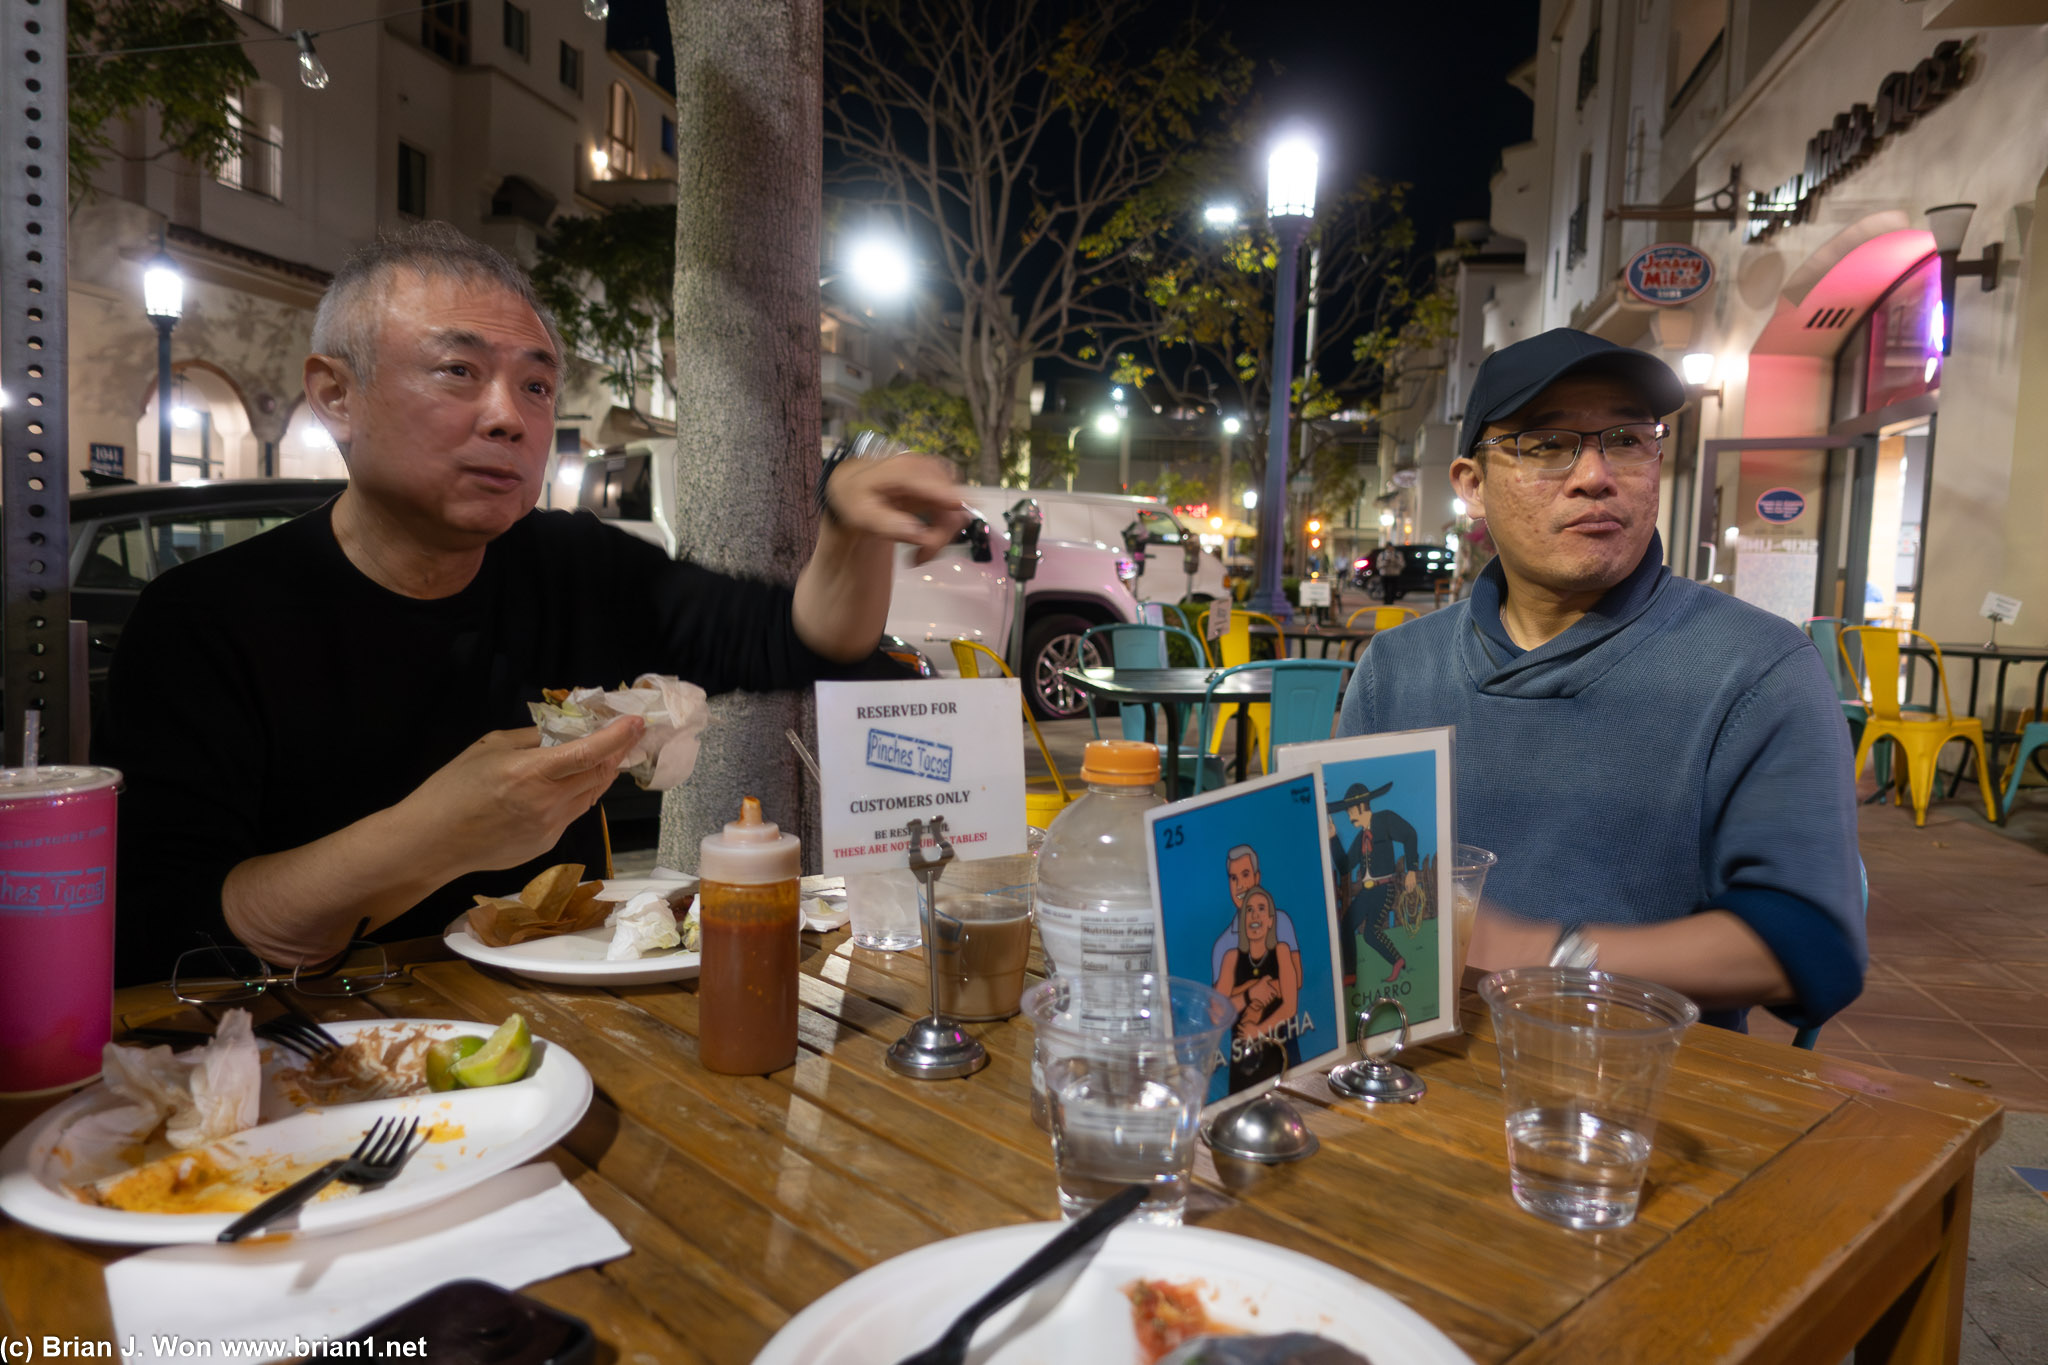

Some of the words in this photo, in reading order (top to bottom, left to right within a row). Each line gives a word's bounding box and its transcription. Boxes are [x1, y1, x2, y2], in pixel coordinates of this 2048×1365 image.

[856, 703, 928, 720] RESERVED
[931, 701, 957, 715] FOR
[869, 734, 914, 768] Pinches
[917, 746, 949, 775] Tacos
[850, 794, 933, 814] CUSTOMERS
[935, 790, 971, 804] ONLY
[833, 846, 867, 858] THESE
[867, 844, 888, 855] ARE
[890, 842, 910, 852] NOT
[950, 831, 988, 844] TABLES!
[874, 830, 887, 840] BE
[1163, 824, 1185, 849] 25
[1351, 980, 1412, 1008] CHARRO
[1232, 1010, 1315, 1062] SANCHA
